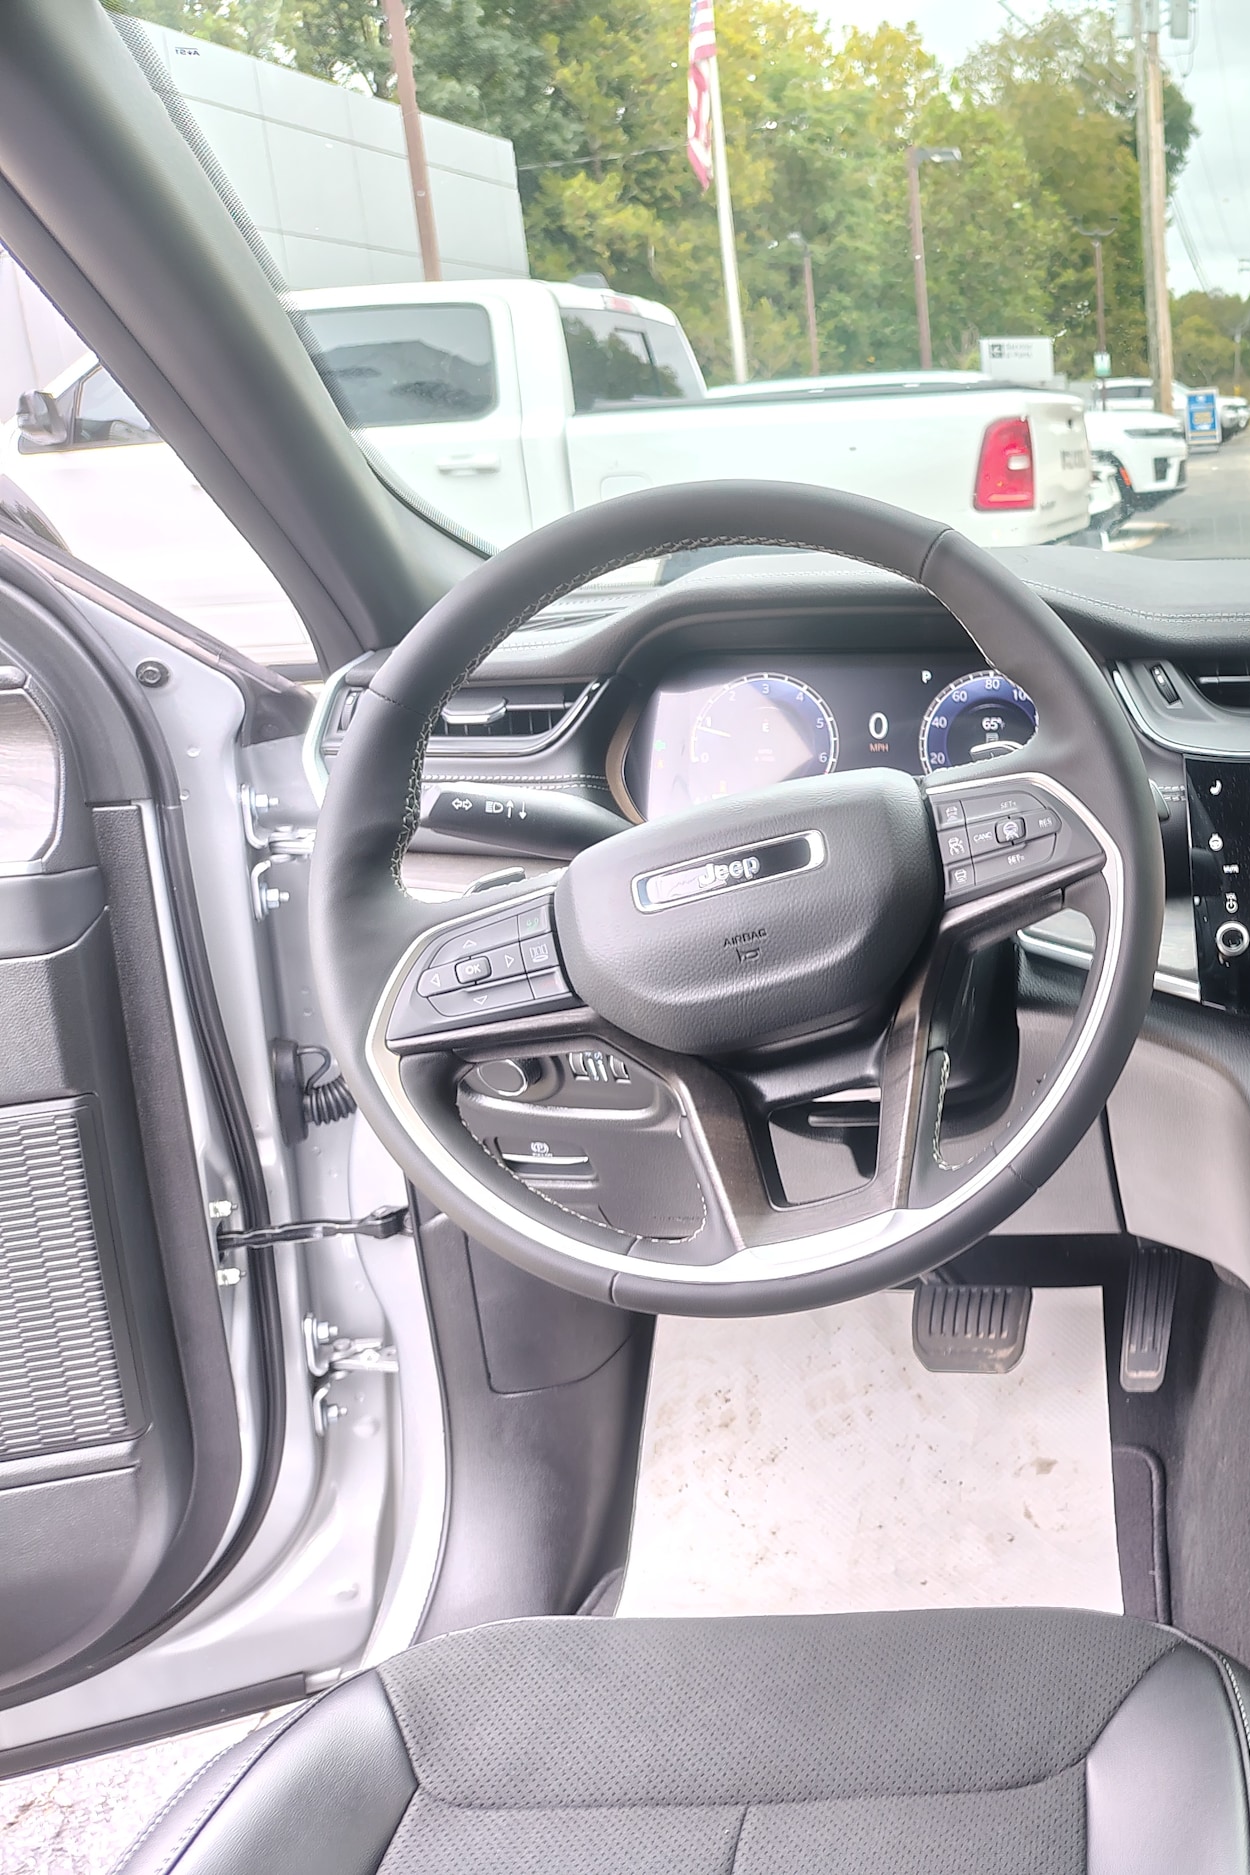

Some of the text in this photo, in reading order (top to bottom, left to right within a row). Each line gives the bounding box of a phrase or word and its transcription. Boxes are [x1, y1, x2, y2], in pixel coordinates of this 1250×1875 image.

[921, 670, 932, 684] P
[761, 684, 770, 694] 3
[985, 679, 1000, 690] 80
[728, 691, 737, 702] 2
[796, 692, 804, 702] 4
[951, 690, 968, 702] 60
[1012, 689, 1030, 701] 10
[762, 722, 770, 733] E
[816, 717, 825, 729] 5
[868, 712, 889, 740] 0
[931, 716, 948, 728] 40
[869, 743, 889, 752] MPH
[819, 752, 828, 763] 6
[930, 752, 946, 765] 20
[1038, 817, 1053, 828] RES
[973, 831, 993, 842] CANC
[698, 856, 760, 888] Jeep
[723, 928, 768, 947] AIRBAG
[465, 963, 481, 975] OK
